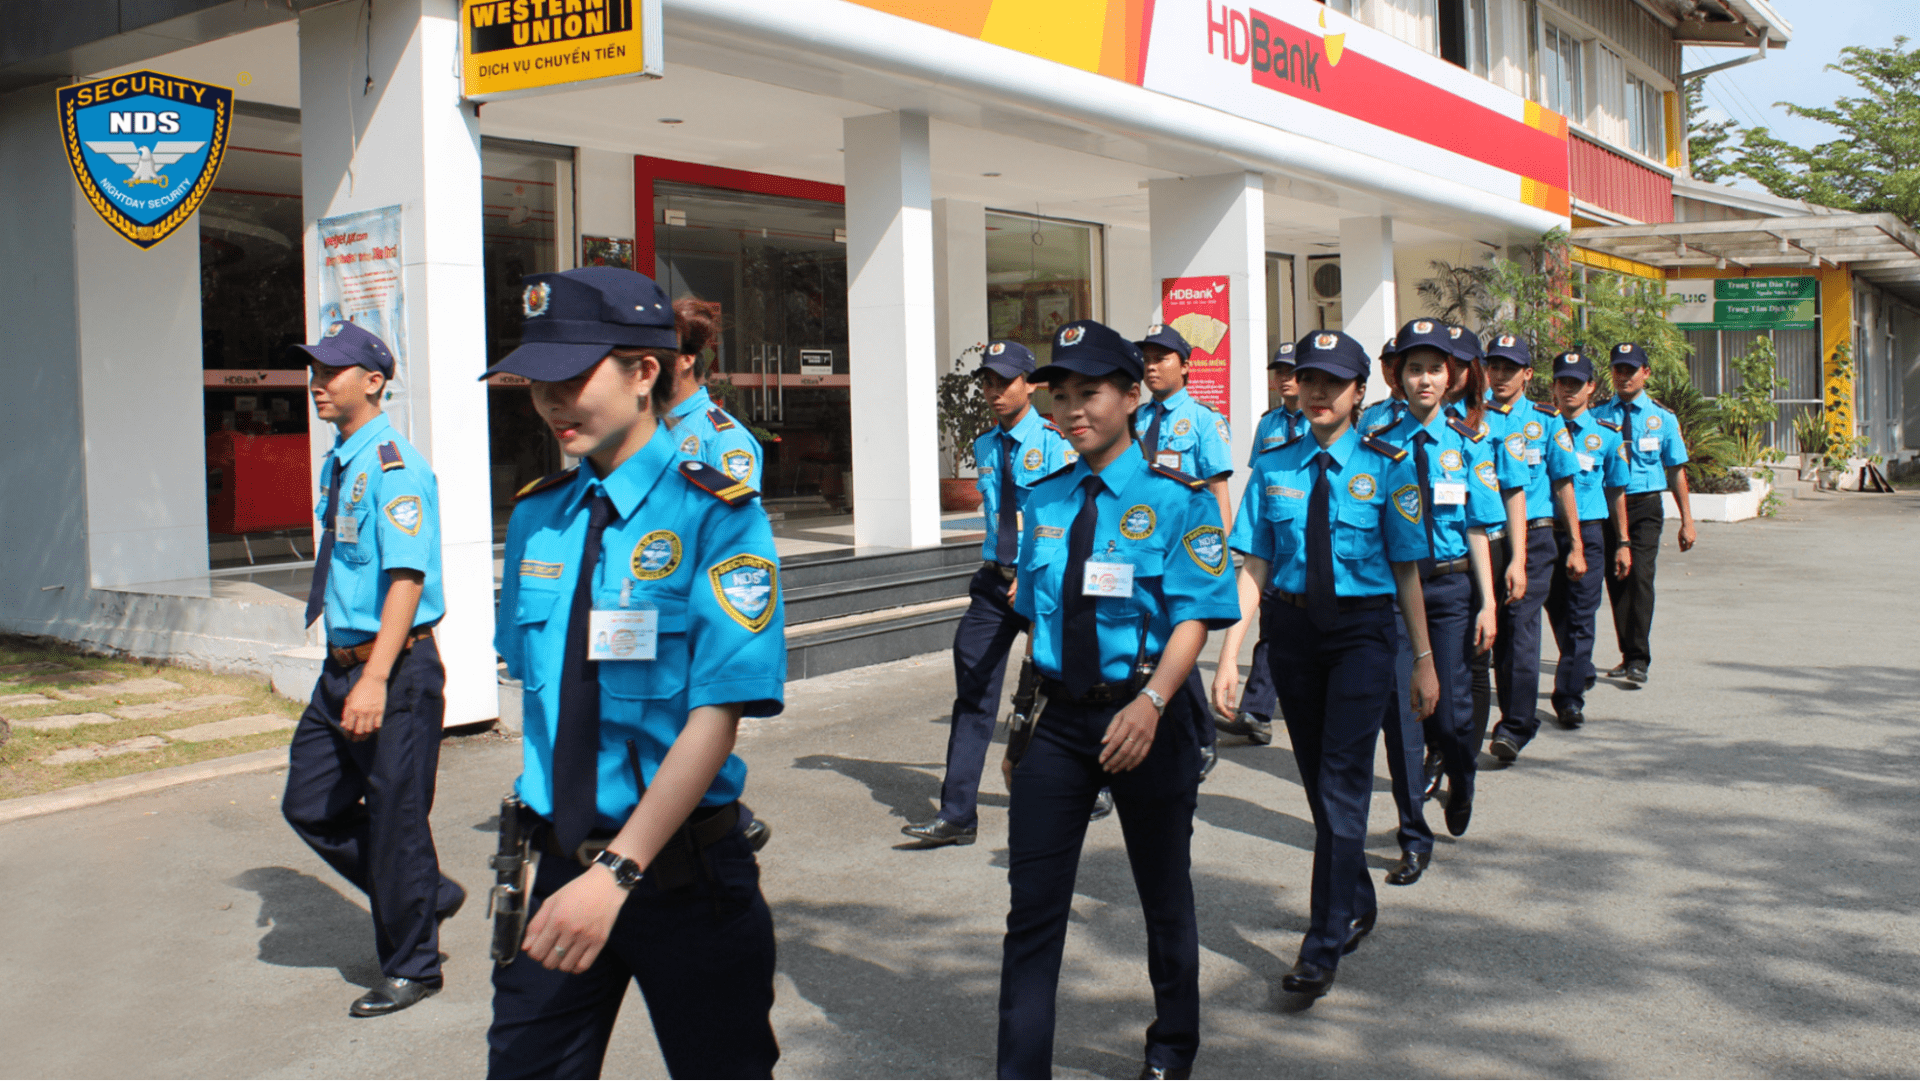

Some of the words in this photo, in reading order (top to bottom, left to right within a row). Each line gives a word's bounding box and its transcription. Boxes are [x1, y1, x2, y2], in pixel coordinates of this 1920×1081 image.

[513, 10, 604, 46] UNION
[1207, 0, 1321, 93] HDBank
[479, 62, 509, 79] DỊCH
[513, 59, 530, 74] VỤ
[1170, 288, 1213, 300] HDBank
[732, 572, 762, 585] NDS
